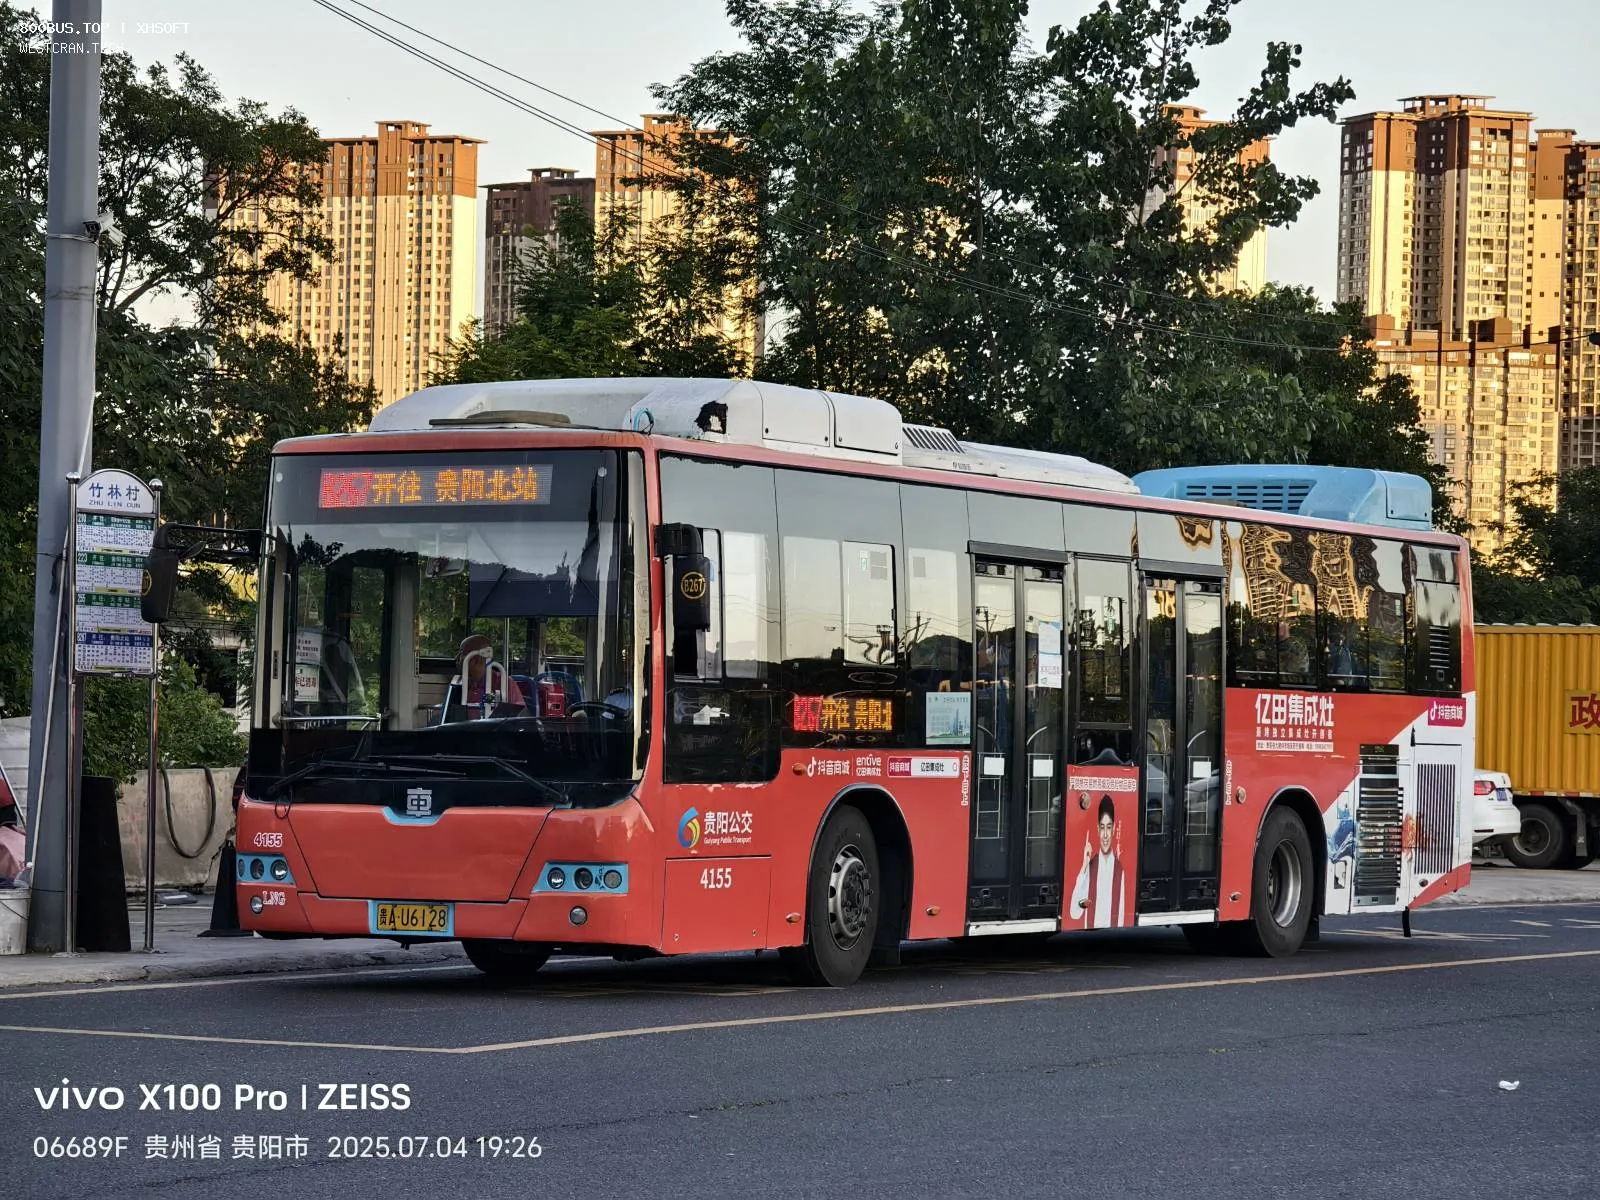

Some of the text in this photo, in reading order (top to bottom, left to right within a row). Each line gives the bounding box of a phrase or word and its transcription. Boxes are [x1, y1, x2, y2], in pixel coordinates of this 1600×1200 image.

[89, 482, 140, 501] 竹林村
[434, 466, 538, 503] 贵阳北站
[107, 500, 123, 508] LIN
[684, 578, 703, 593] B267
[1254, 693, 1335, 728] 亿田集成灶
[1438, 704, 1464, 720] 抖音商城
[817, 759, 850, 777] 抖音商城
[855, 754, 882, 766] entive
[703, 810, 753, 835] 贵阳公交
[253, 832, 284, 848] 4155
[700, 867, 732, 889] 4155
